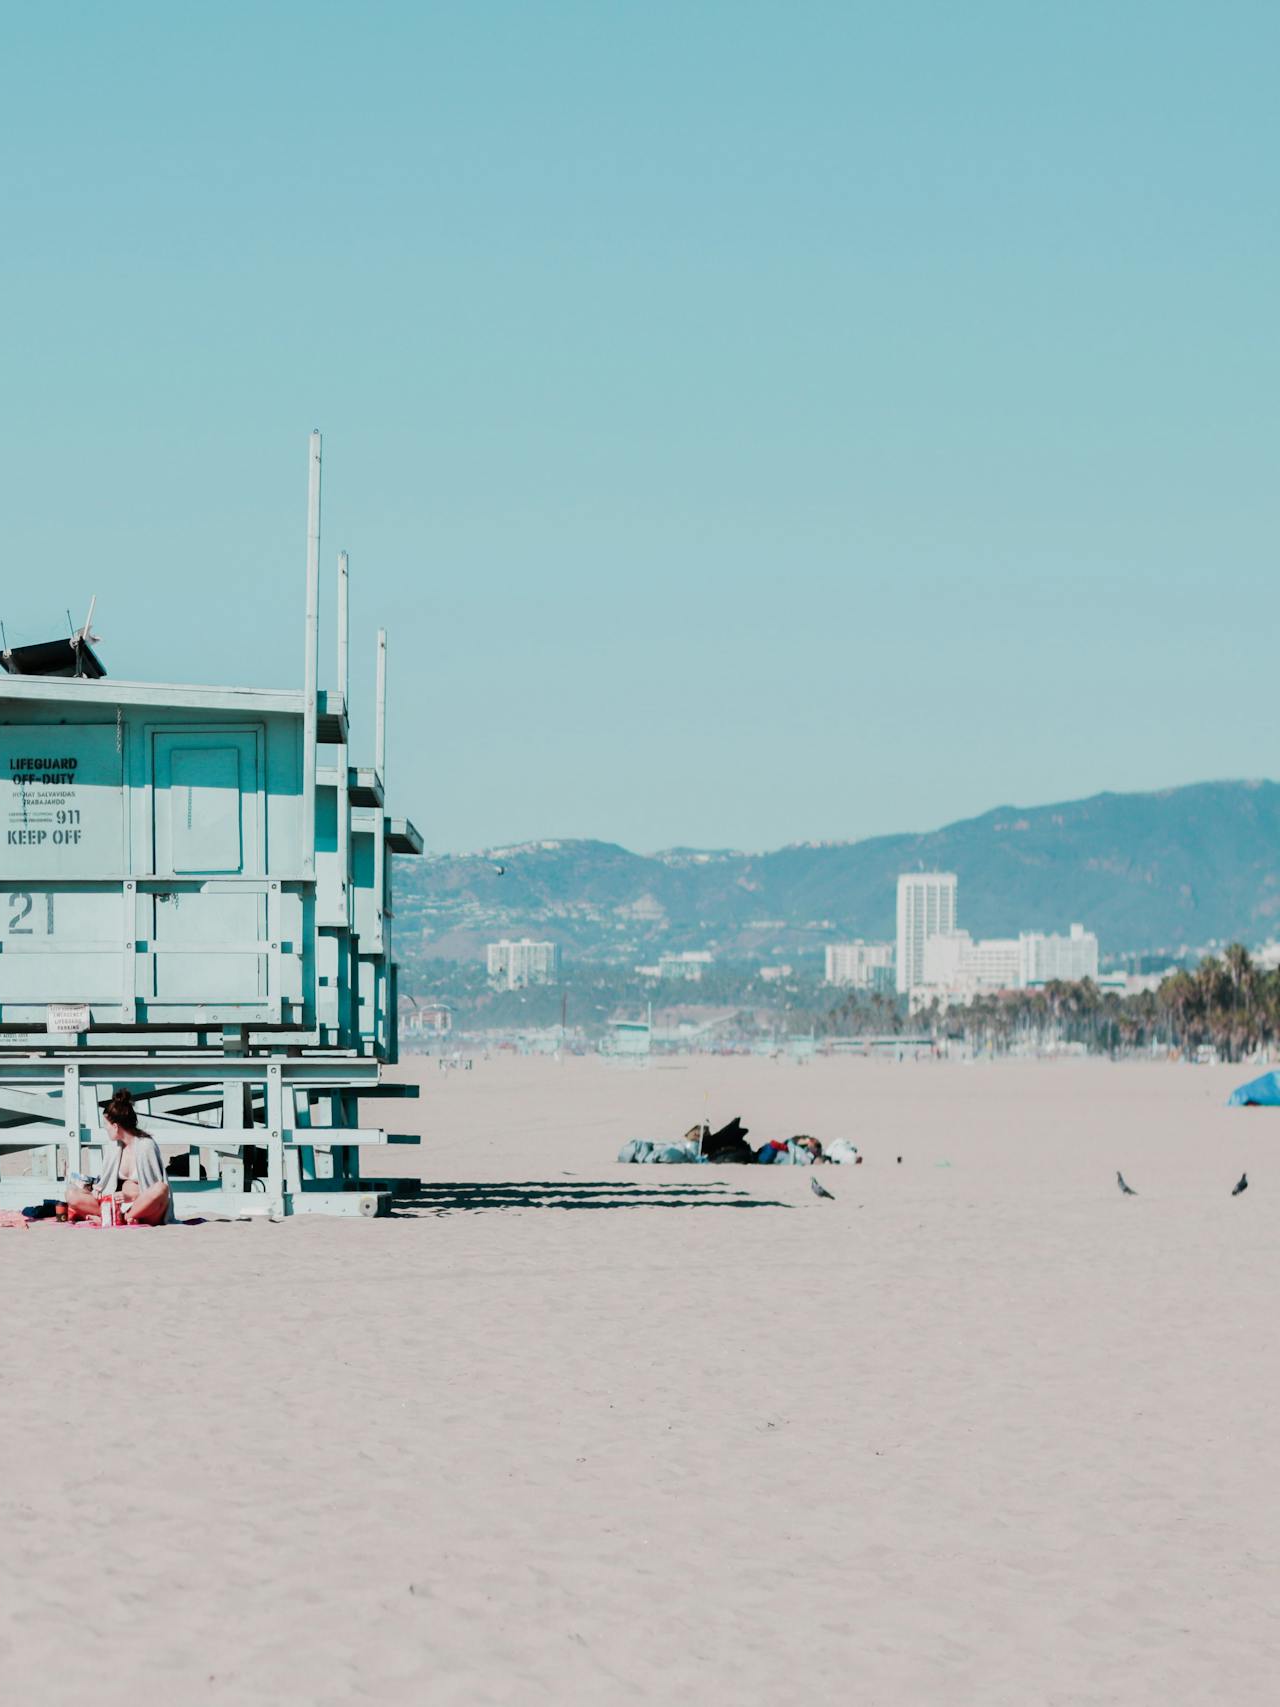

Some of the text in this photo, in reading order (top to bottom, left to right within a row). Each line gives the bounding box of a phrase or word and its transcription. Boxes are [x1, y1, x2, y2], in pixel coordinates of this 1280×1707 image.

[10, 758, 78, 770] LIFEGUARD
[12, 773, 75, 785] OFF-DUTY
[56, 809, 80, 824] 911
[8, 830, 81, 845] KEEP OFF
[8, 893, 54, 935] 21
